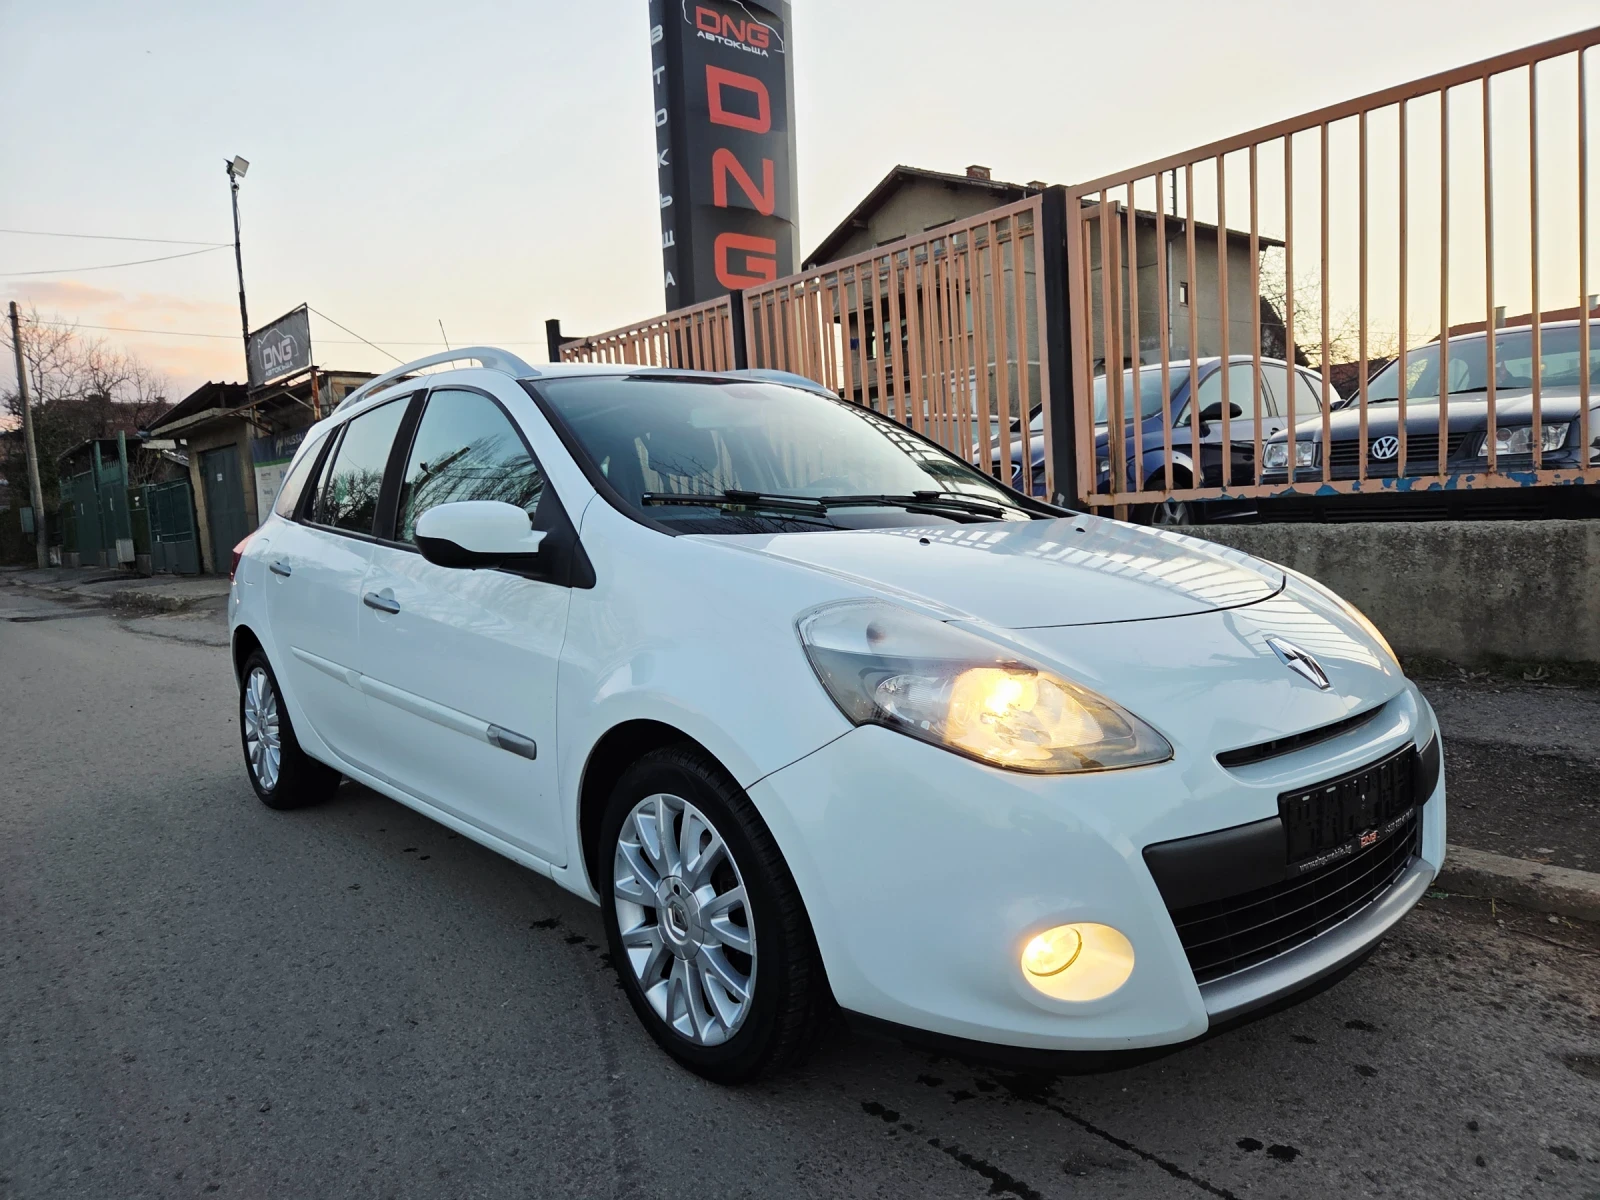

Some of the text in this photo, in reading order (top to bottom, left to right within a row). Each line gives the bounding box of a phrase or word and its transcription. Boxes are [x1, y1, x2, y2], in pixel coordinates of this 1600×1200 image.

[695, 6, 769, 48] DNG
[706, 64, 777, 290] DNG
[263, 338, 292, 370] DNG
[284, 431, 308, 447] MUSSAL
[1361, 832, 1377, 848] DNG
